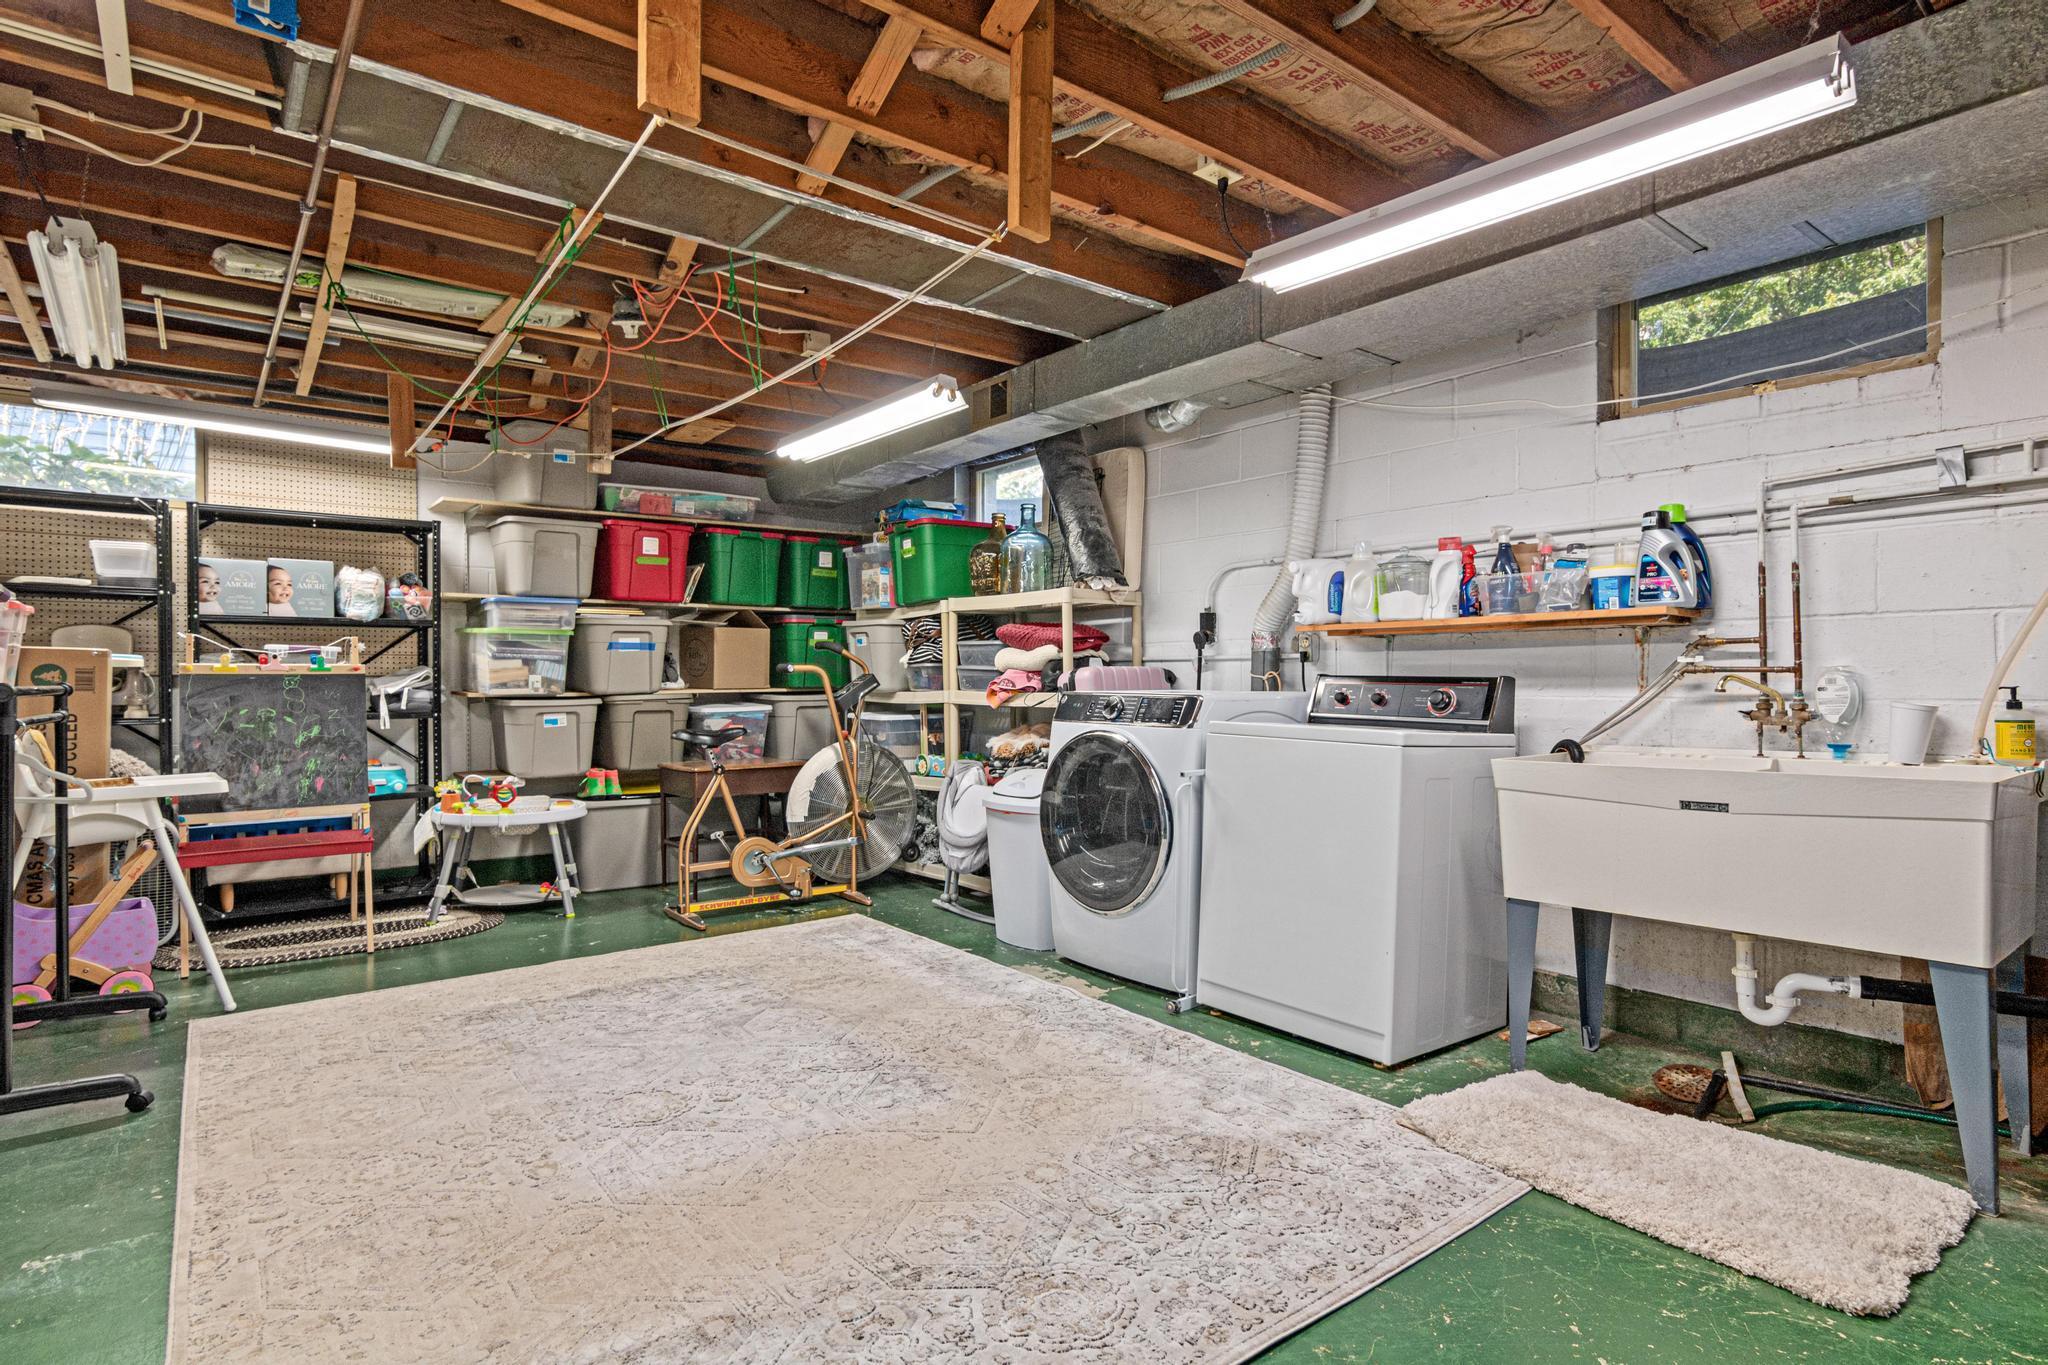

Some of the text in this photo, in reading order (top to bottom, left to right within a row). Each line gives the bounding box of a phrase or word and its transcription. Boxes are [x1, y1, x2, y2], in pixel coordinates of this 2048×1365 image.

[1200, 32, 1234, 53] PINK
[1211, 33, 1256, 61] NEXT GEN
[1221, 35, 1273, 67] FIBERGLAS
[225, 581, 257, 589] AMORE
[297, 582, 328, 590] AMORE
[699, 901, 737, 910] SCHWINN
